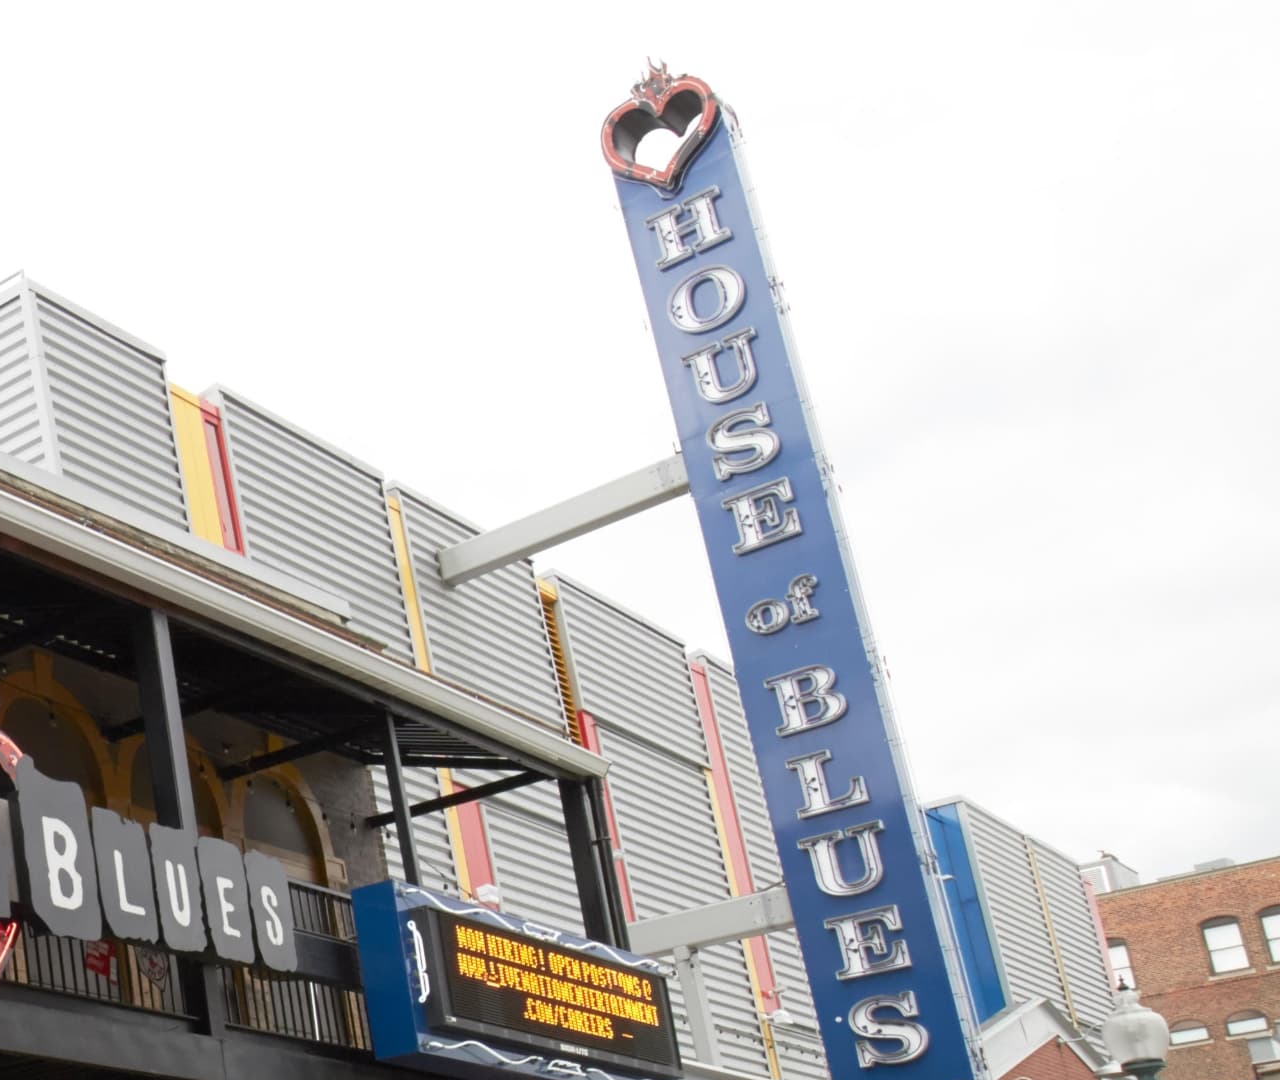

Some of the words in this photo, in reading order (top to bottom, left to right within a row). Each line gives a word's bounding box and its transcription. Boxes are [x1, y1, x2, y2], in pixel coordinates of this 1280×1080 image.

[645, 184, 804, 555] HOUSE
[744, 573, 822, 637] of
[41, 815, 284, 947] BLUES
[764, 664, 930, 1069] BLUES
[548, 952, 582, 981] OPEN
